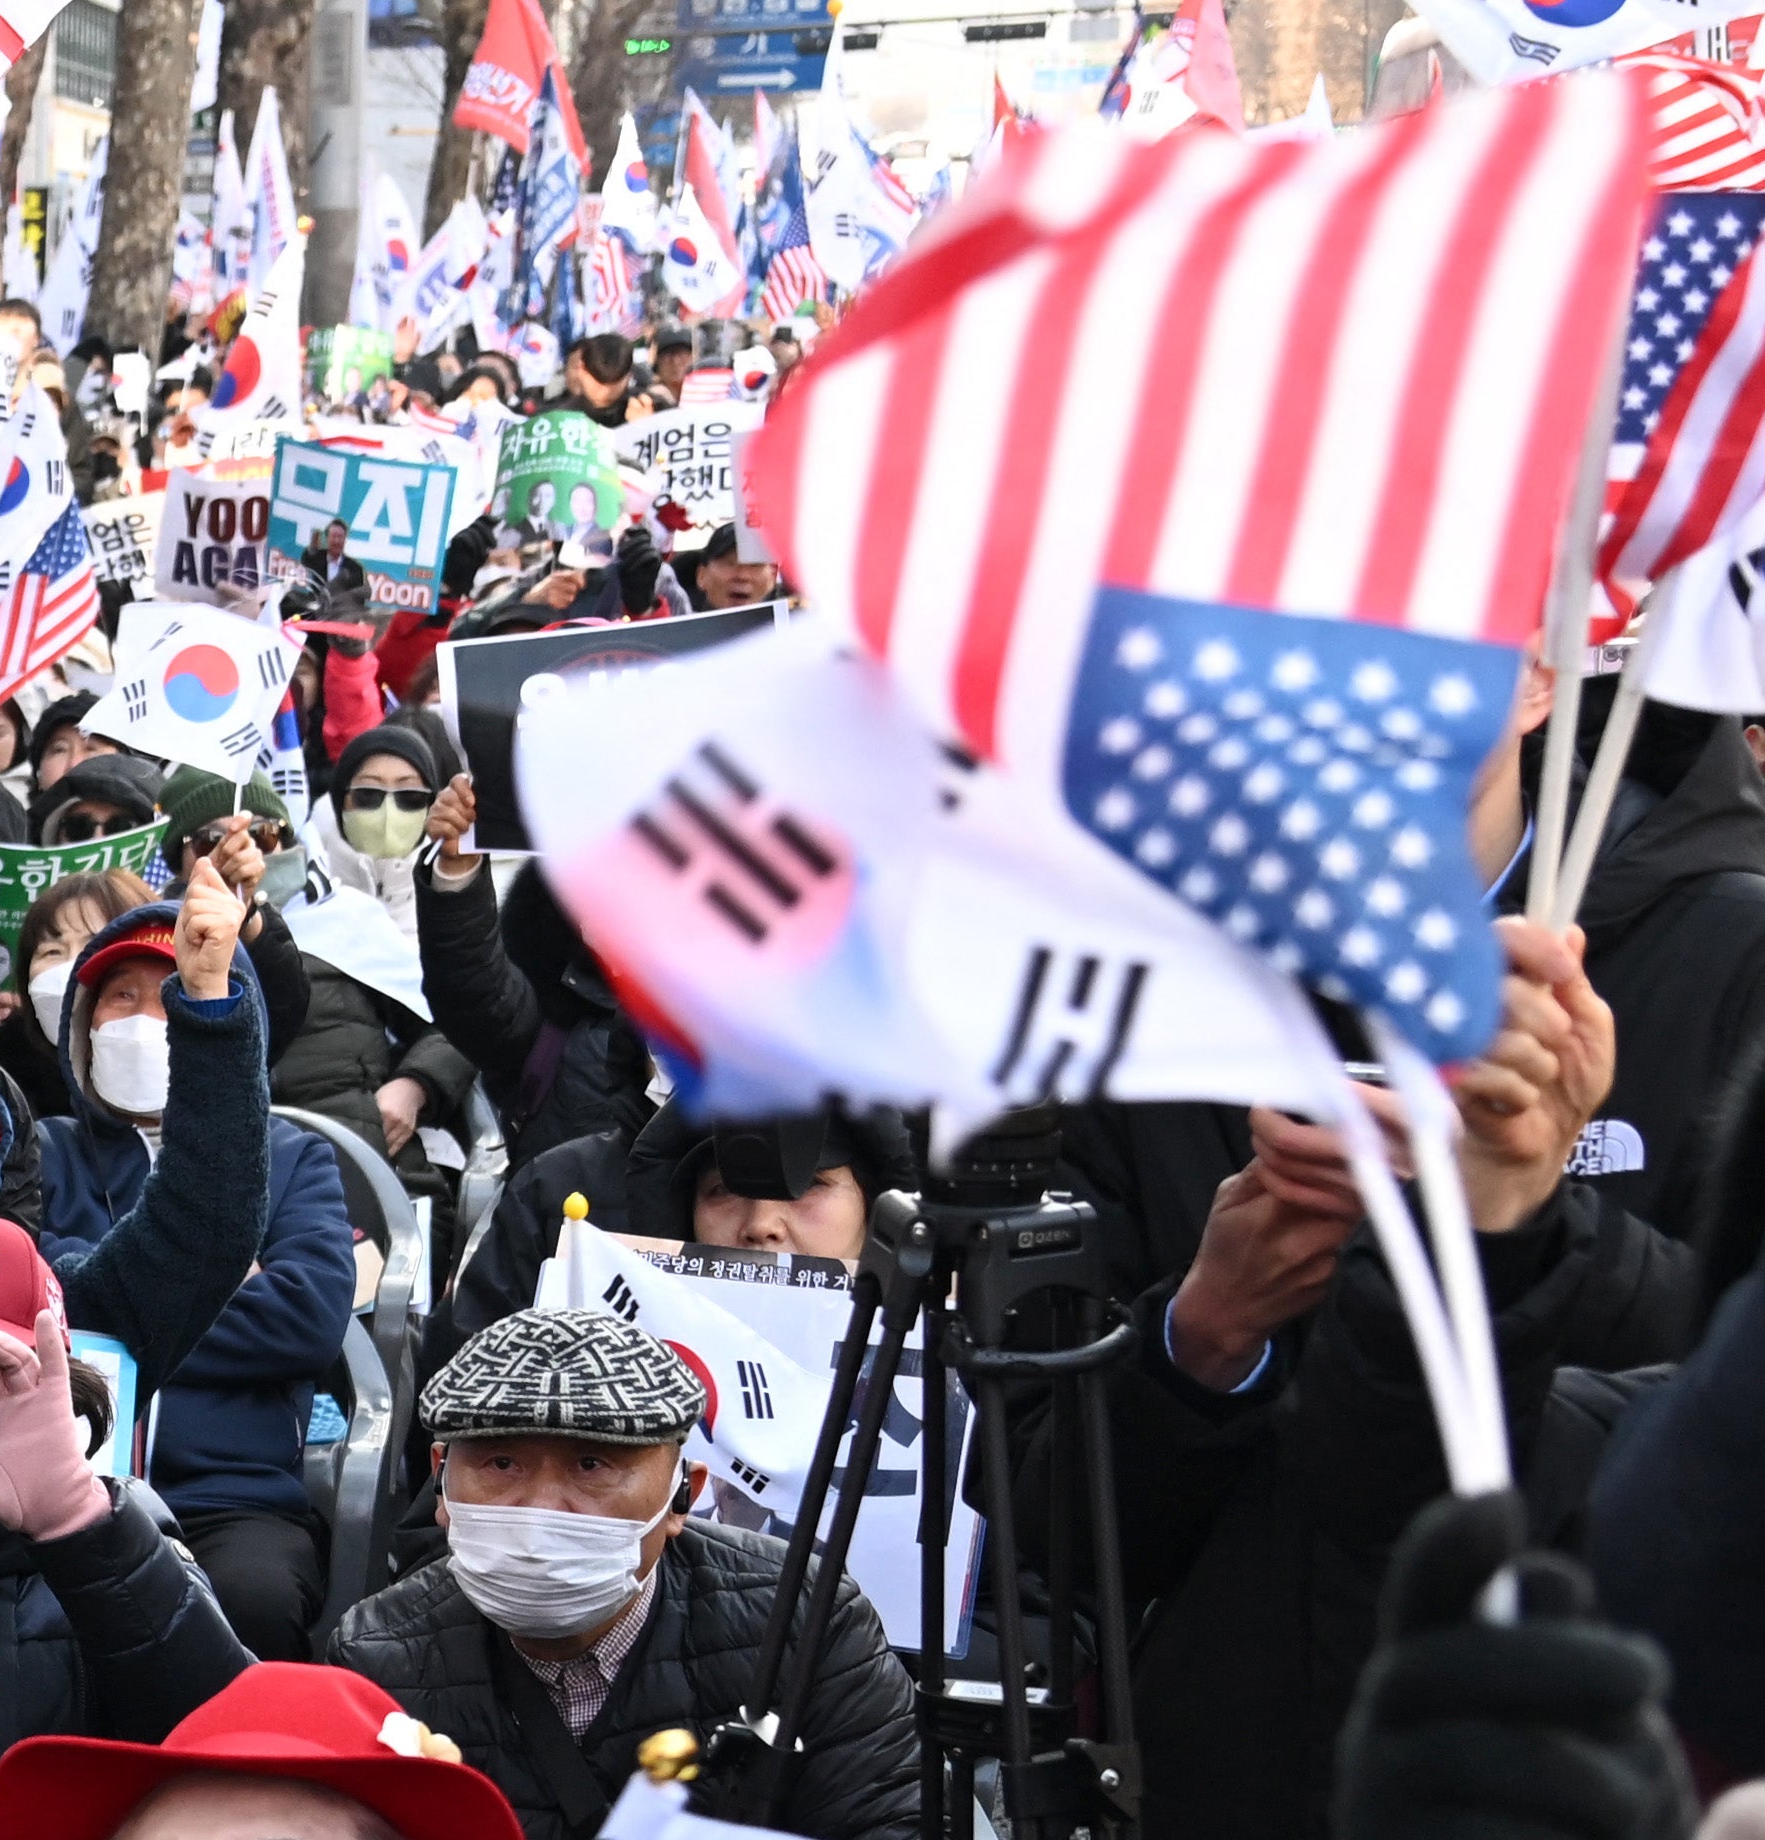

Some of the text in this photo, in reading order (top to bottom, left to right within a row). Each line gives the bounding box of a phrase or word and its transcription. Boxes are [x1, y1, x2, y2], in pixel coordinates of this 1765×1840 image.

[270, 442, 453, 569] 무죄
[369, 572, 432, 611] Yoon
[796, 1265, 830, 1288] 위한
